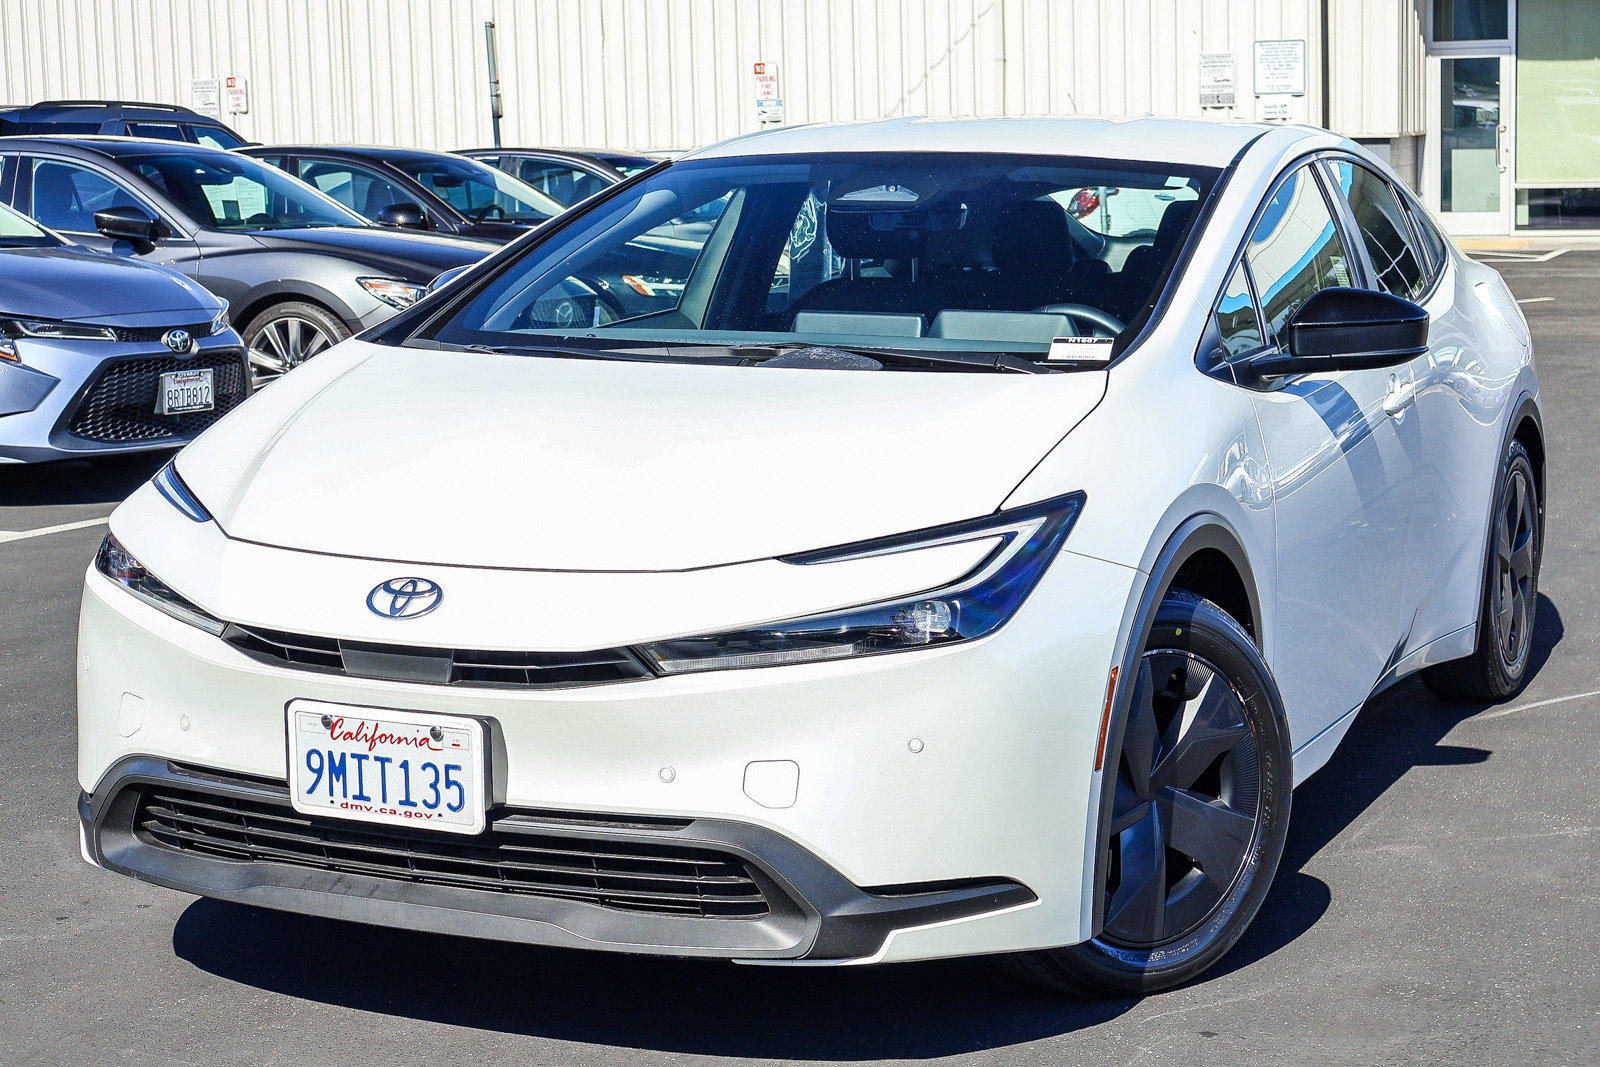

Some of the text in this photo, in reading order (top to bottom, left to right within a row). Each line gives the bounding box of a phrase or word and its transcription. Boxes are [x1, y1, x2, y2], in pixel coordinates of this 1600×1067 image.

[167, 386, 210, 407] 8RTB812
[330, 718, 443, 752] California
[306, 748, 465, 813] 9MIT135
[340, 801, 433, 820] dmv.ca.gov
